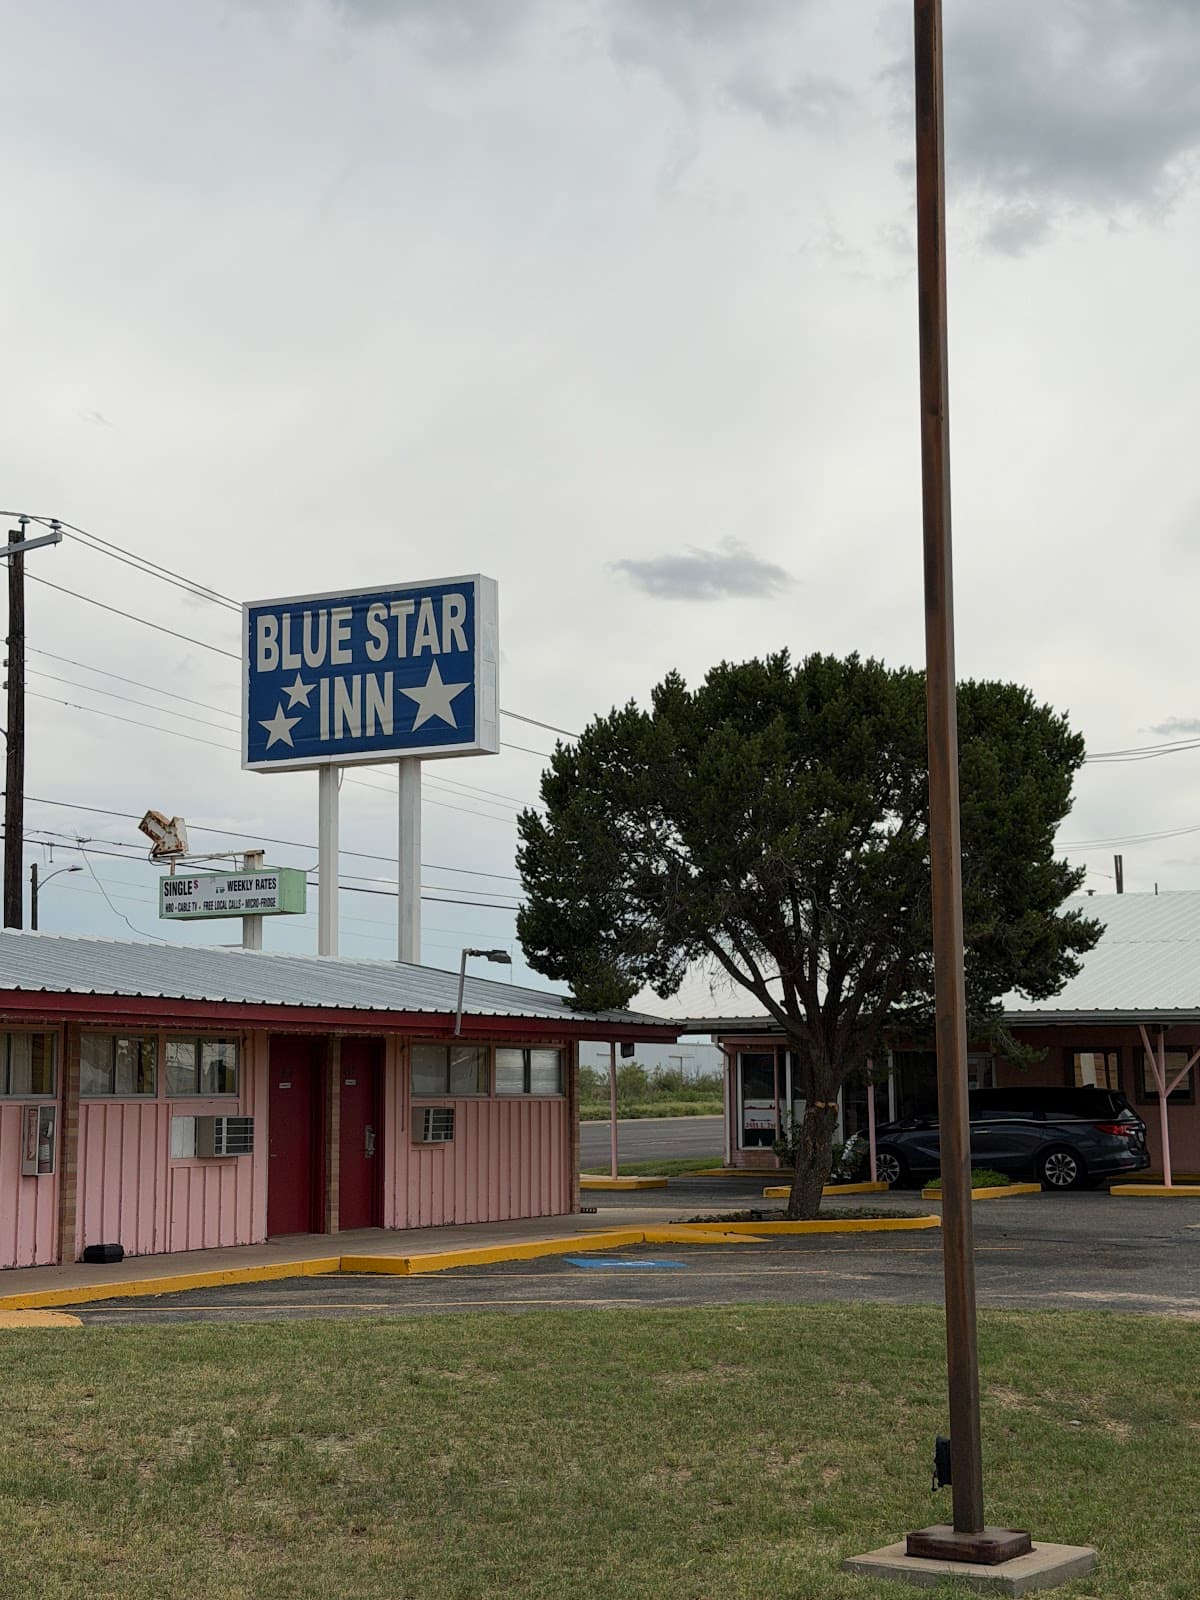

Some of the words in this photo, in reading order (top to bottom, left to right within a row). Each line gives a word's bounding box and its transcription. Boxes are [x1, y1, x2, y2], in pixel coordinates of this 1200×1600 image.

[256, 606, 353, 673] BLUE
[365, 593, 469, 662] STAR
[319, 671, 394, 741] INN
[164, 880, 193, 897] SINGLE
[227, 879, 254, 892] WEEKLY
[255, 878, 277, 890] RATES
[178, 901, 191, 912] CABLE
[192, 901, 198, 911] TV
[203, 900, 213, 911] FREE
[214, 899, 228, 910] LOCAL
[229, 898, 241, 910] CALLS
